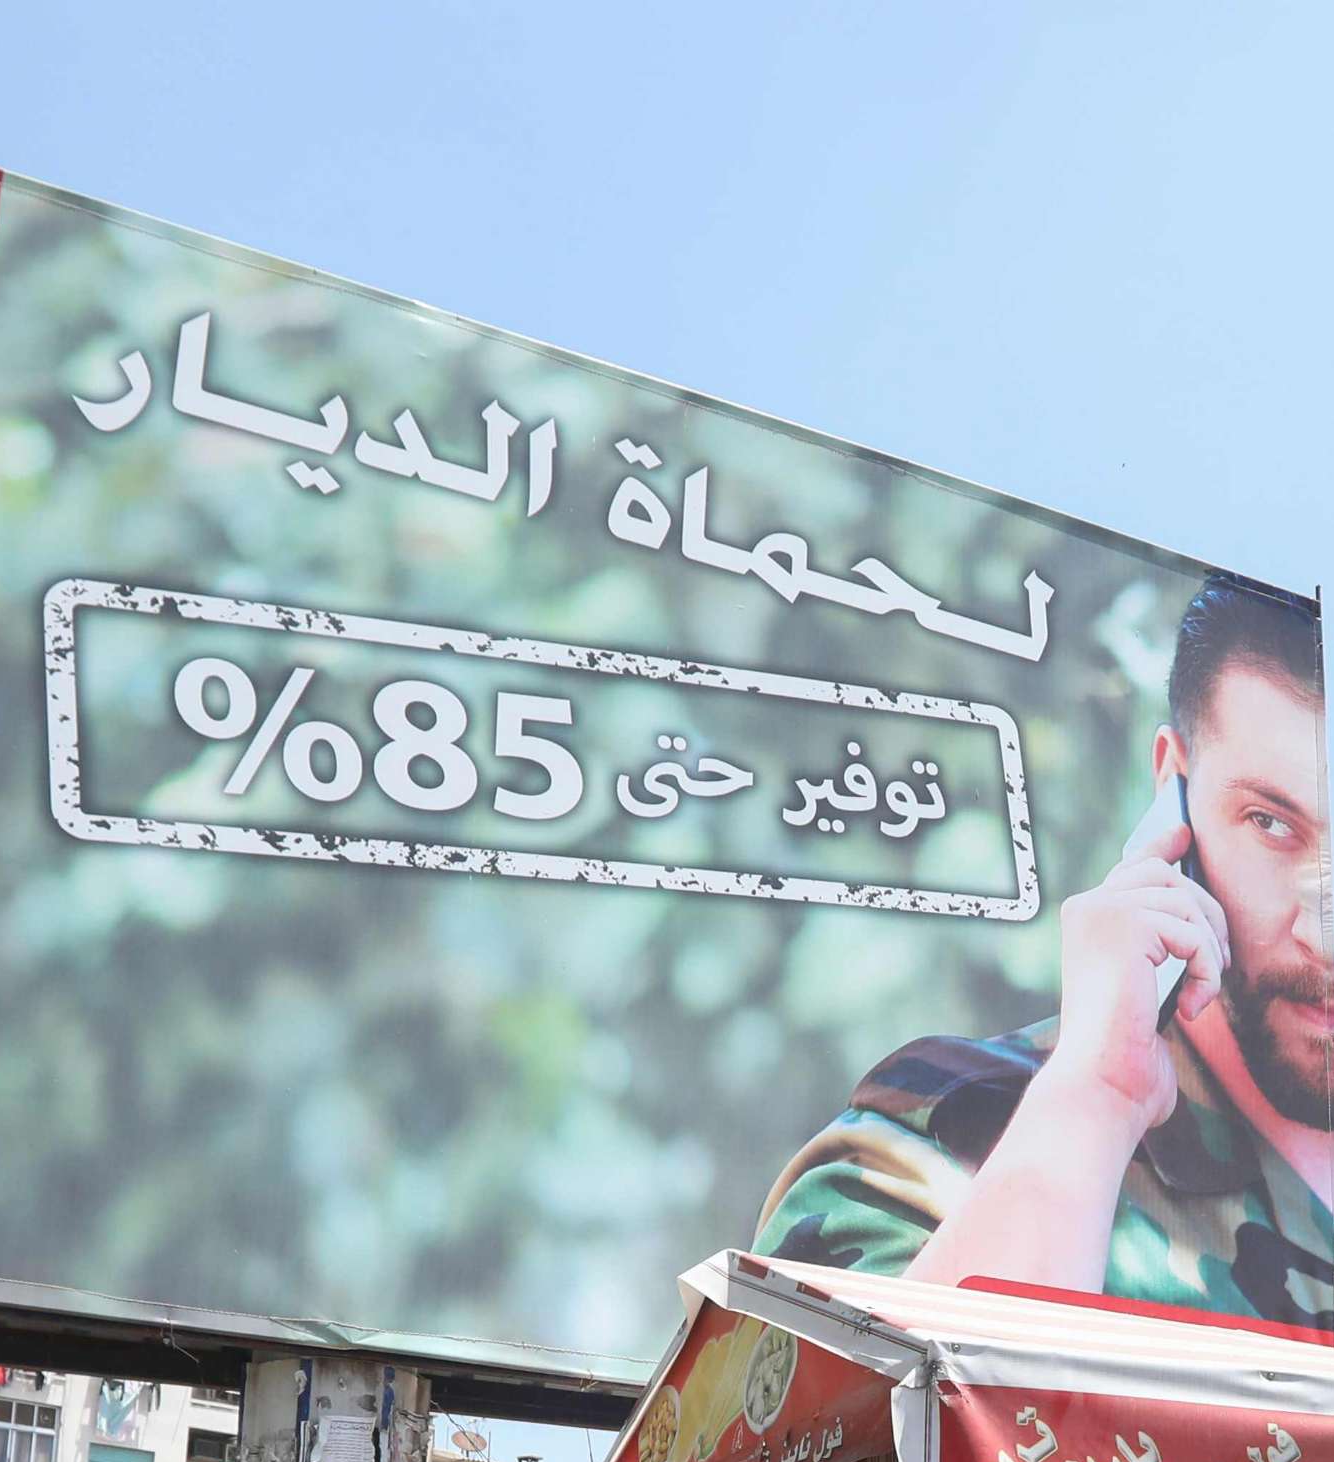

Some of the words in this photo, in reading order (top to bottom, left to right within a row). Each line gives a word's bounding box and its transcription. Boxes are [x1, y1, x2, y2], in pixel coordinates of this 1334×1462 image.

[72, 312, 560, 520] الديار
[606, 438, 1056, 664] لحماة
[617, 734, 754, 818] حتى
[782, 741, 946, 839] توفير
